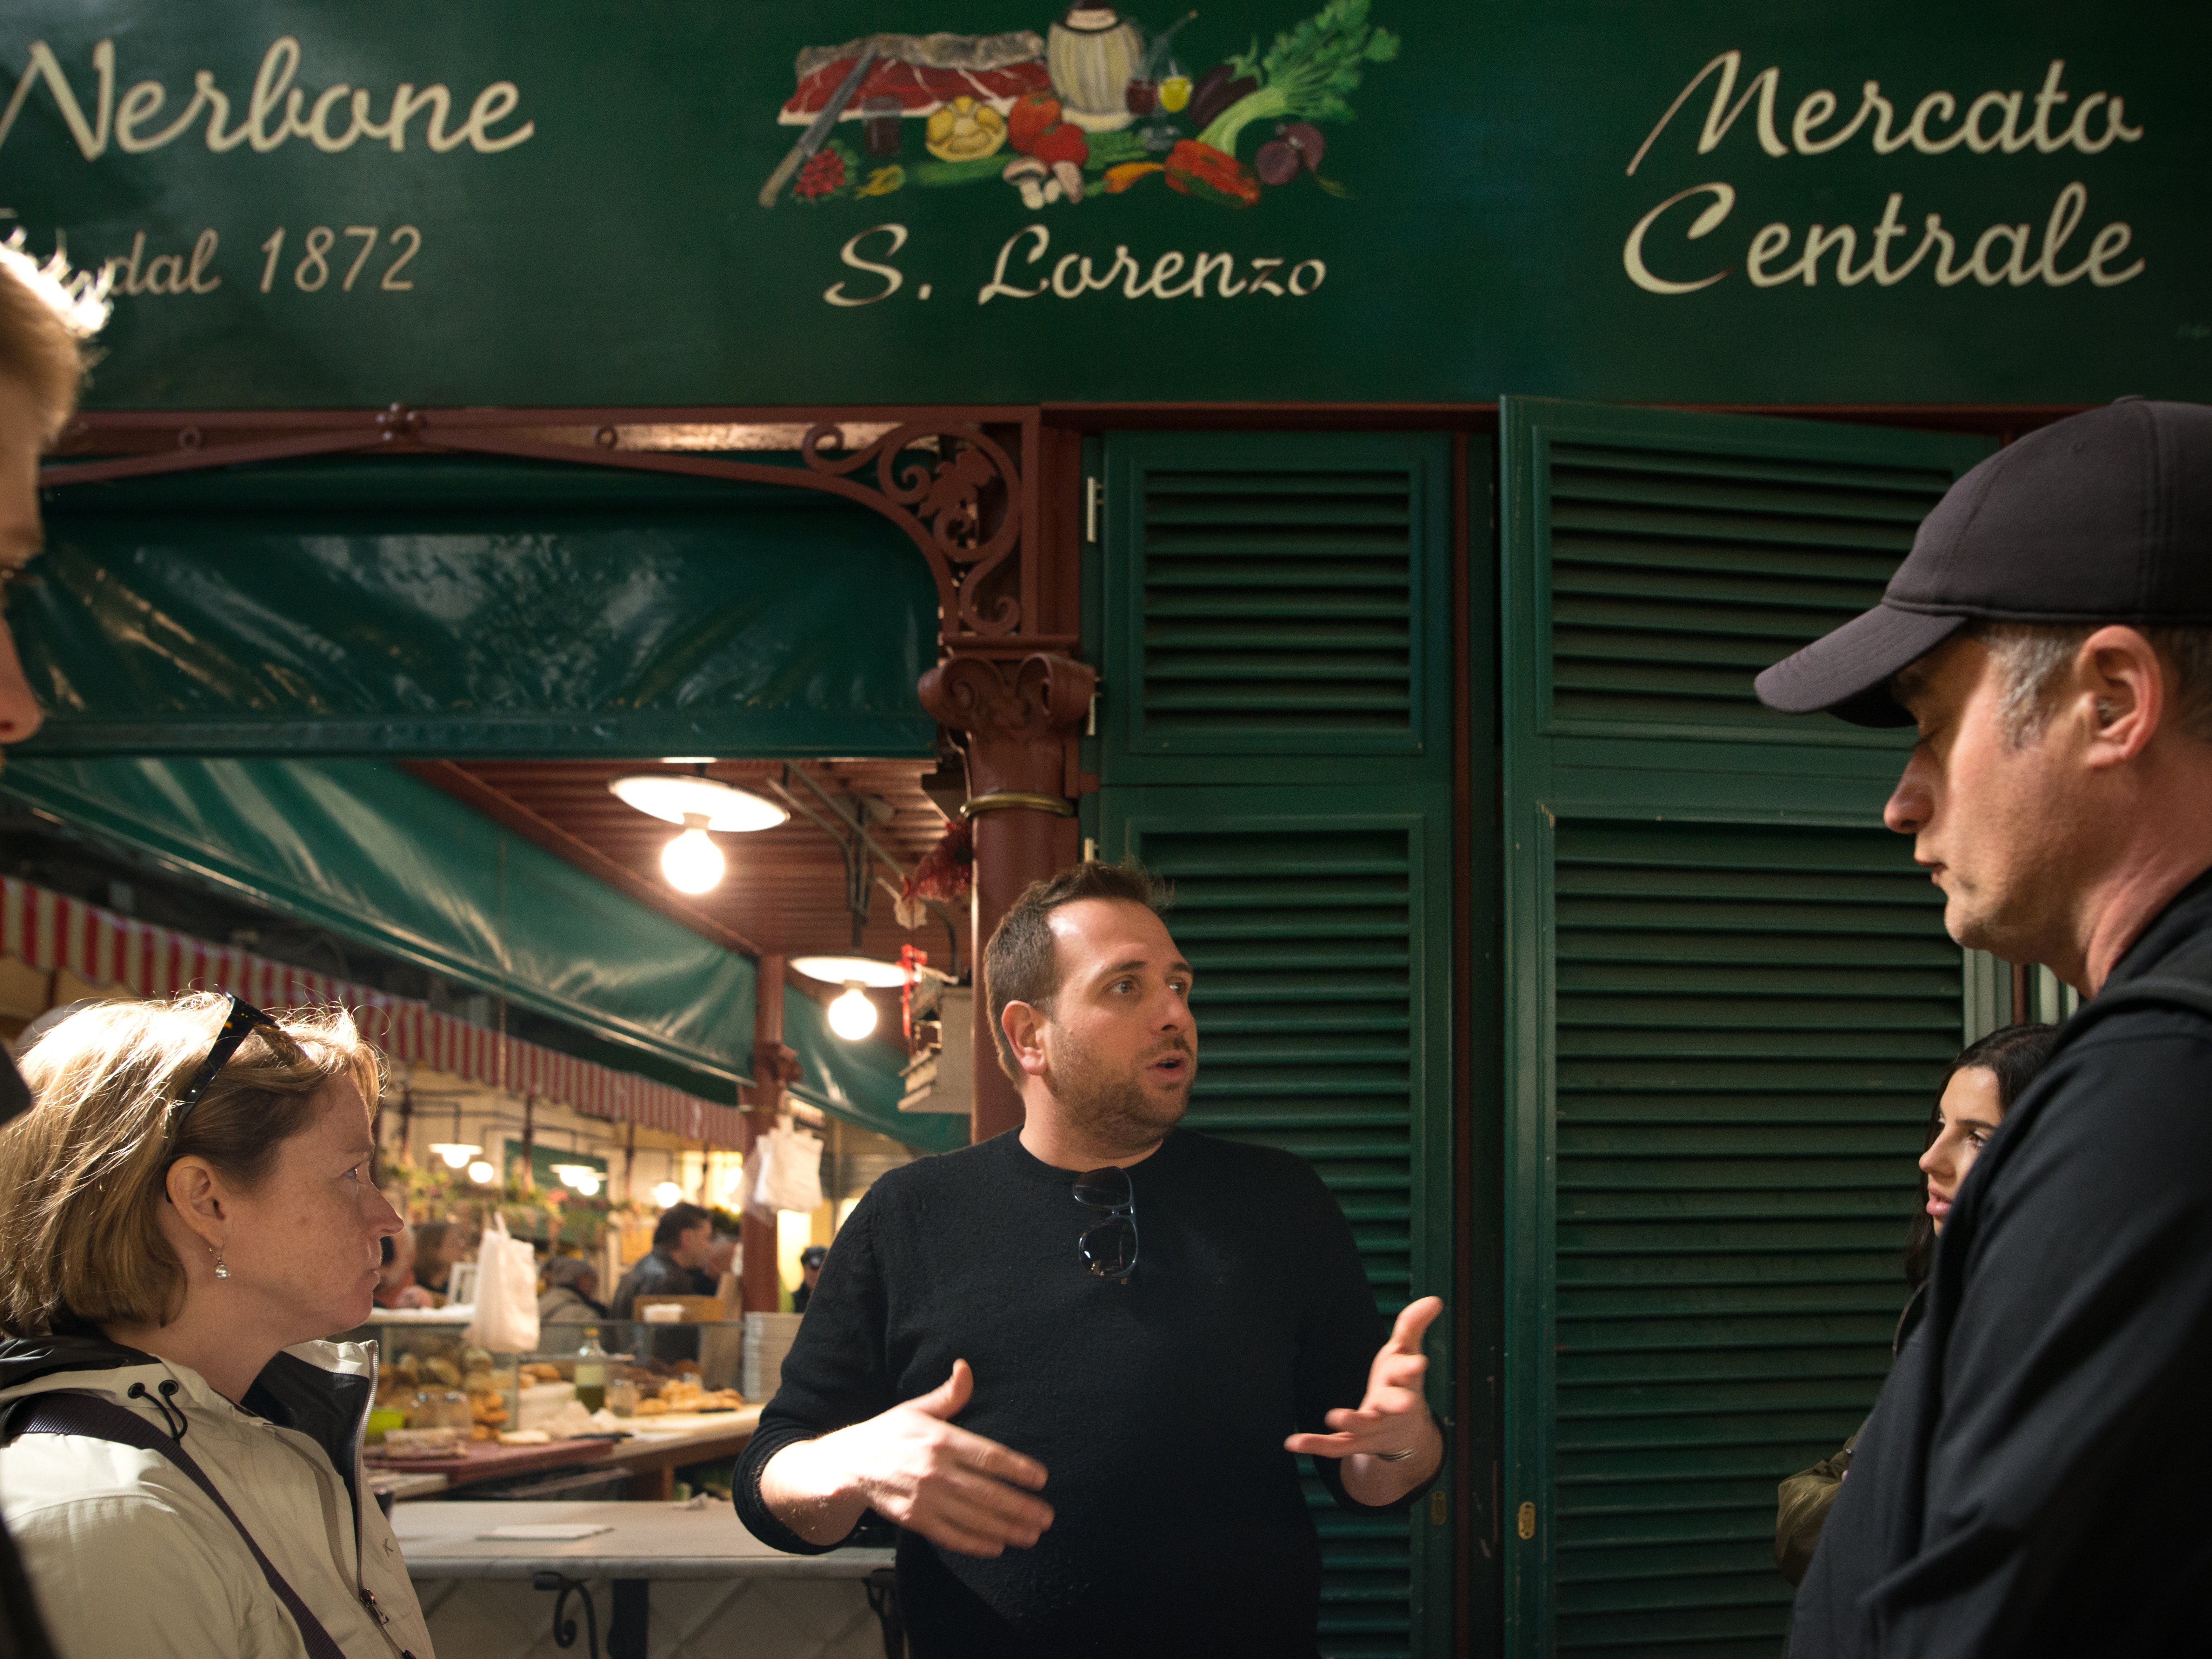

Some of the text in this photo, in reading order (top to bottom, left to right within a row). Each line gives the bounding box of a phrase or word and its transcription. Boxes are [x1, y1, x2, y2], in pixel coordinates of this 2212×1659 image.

[0, 34, 535, 161] Nerbone
[1626, 49, 2143, 175] Mercato
[106, 227, 222, 296] dal
[260, 225, 421, 293] 1872
[823, 223, 1326, 307] S. Lorenzo
[1623, 181, 2145, 294] Centrale
